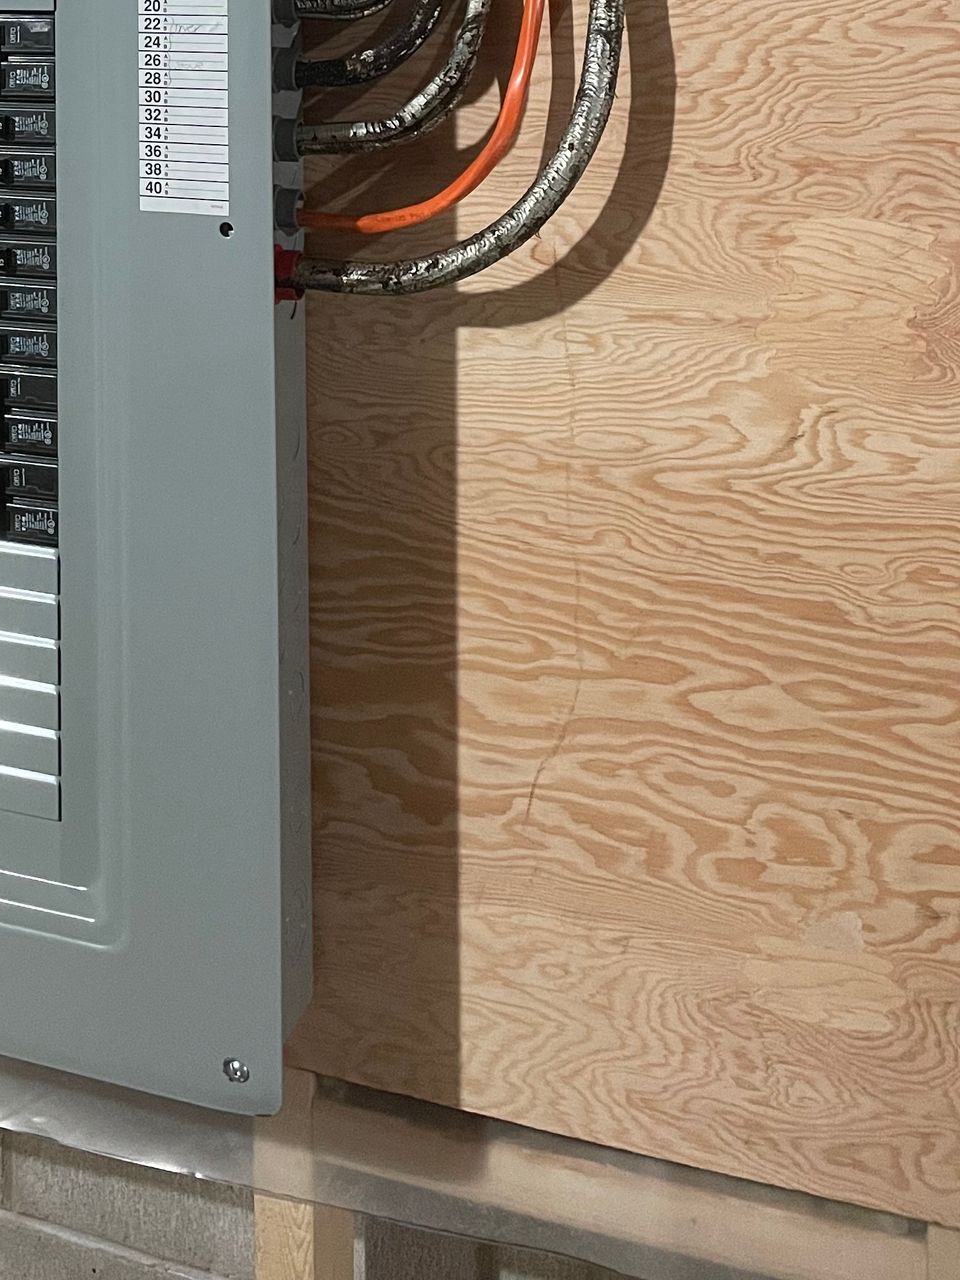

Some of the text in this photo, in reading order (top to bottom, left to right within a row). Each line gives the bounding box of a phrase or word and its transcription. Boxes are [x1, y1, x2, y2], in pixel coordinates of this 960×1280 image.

[144, 0, 160, 12] 20
[144, 18, 160, 30] 22
[144, 36, 160, 48] 24
[144, 54, 160, 66] 26
[144, 72, 162, 84] 28
[144, 90, 162, 102] 30
[144, 108, 162, 120] 32
[144, 126, 162, 140] 34
[144, 144, 162, 158] 36
[146, 162, 162, 176] 38
[146, 182, 162, 194] 40
